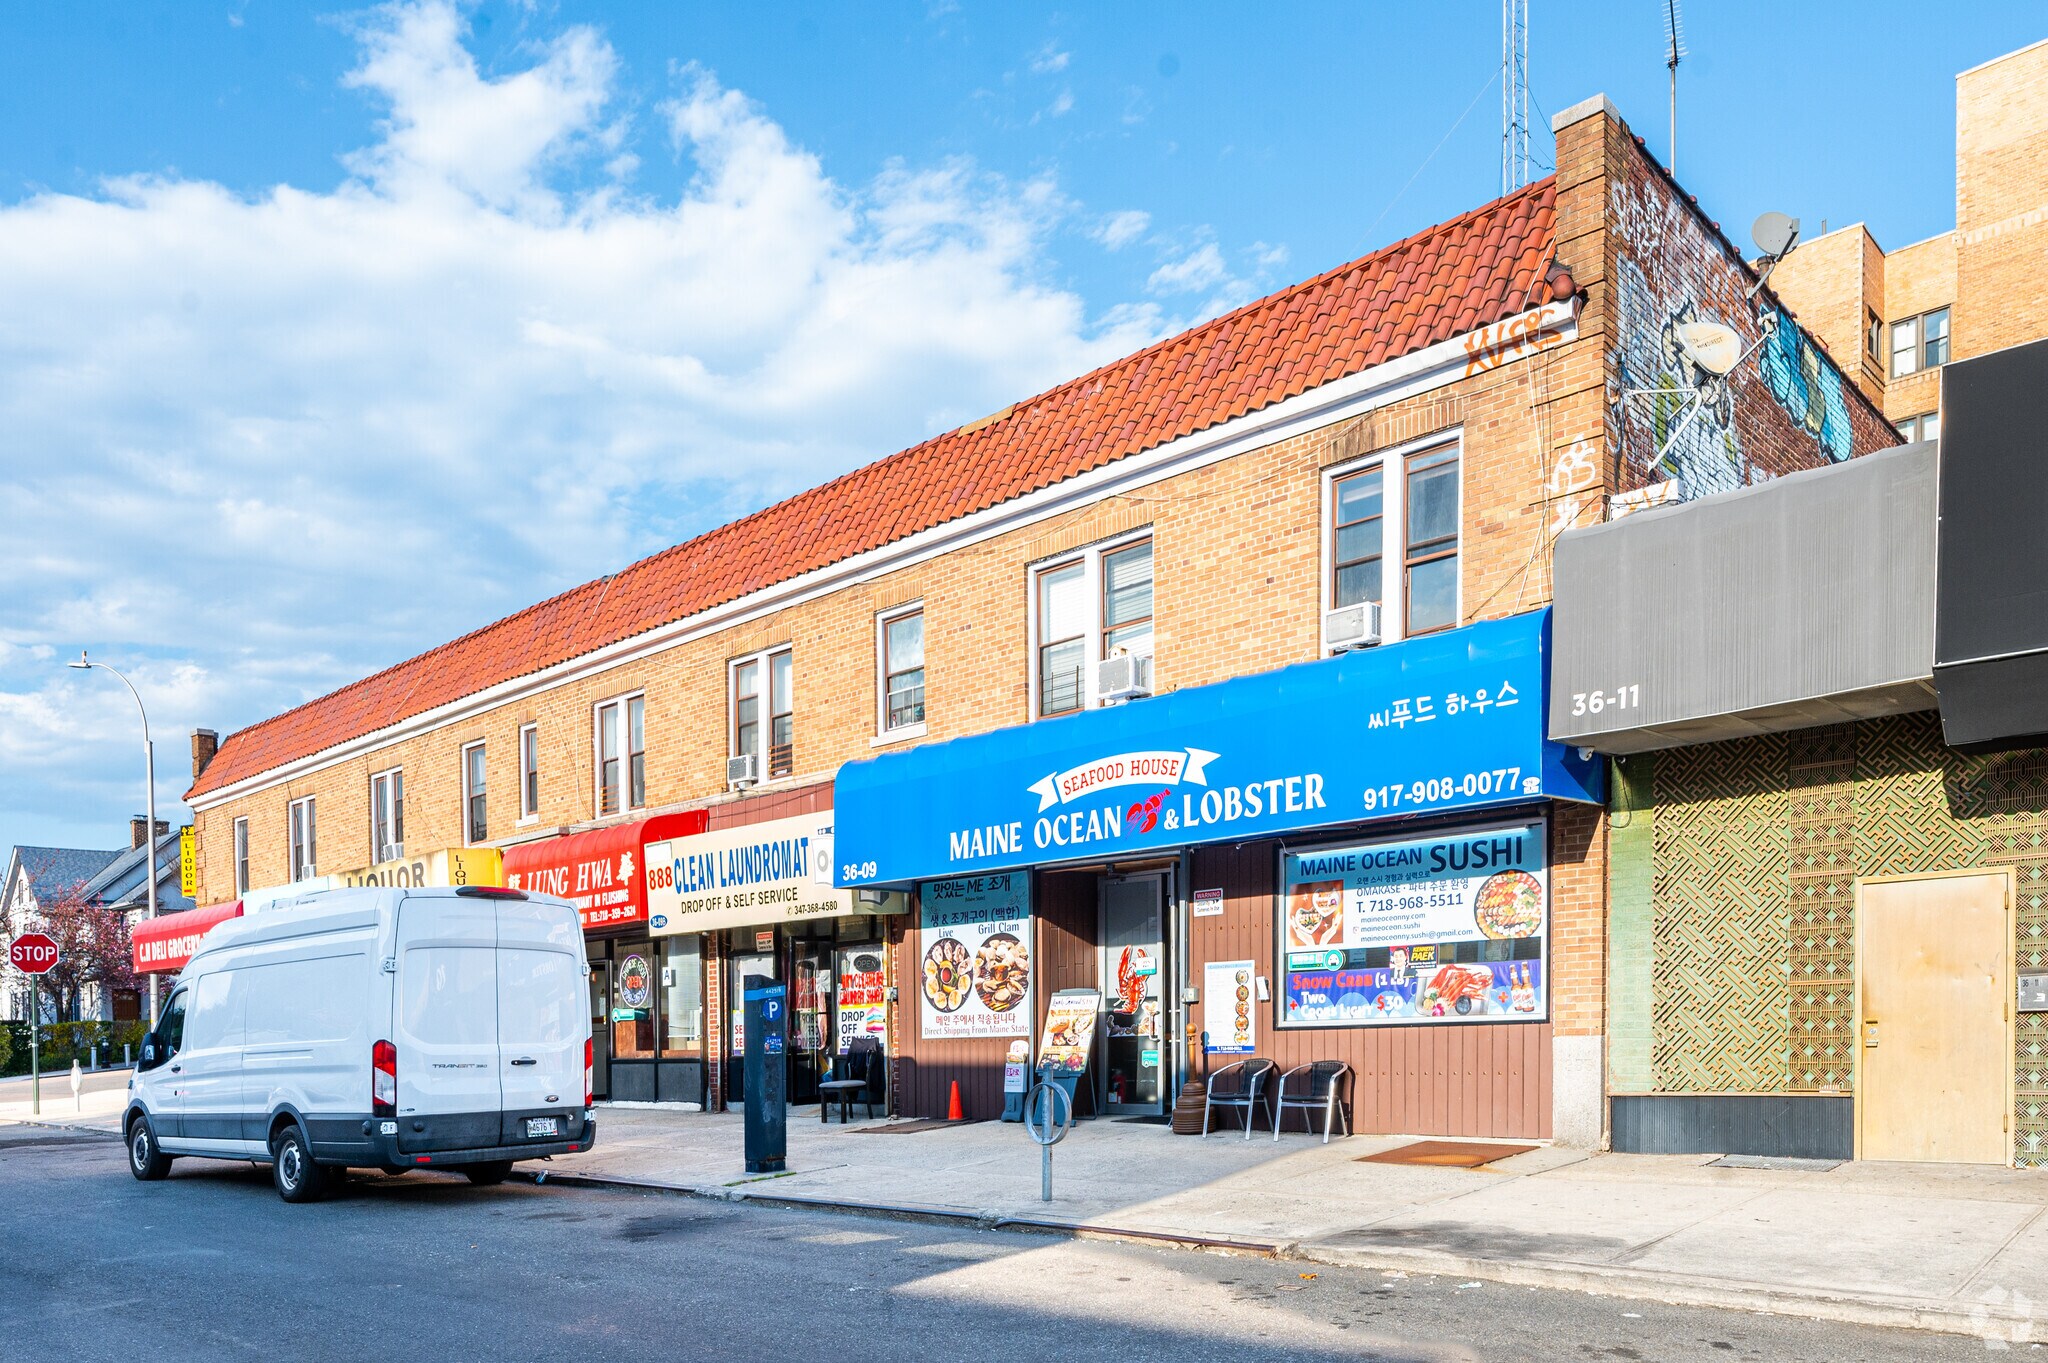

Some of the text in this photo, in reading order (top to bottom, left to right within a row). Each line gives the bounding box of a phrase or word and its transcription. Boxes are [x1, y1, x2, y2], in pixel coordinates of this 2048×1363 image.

[1368, 680, 1519, 729] 씨푸드 하우스
[1572, 684, 1639, 716] 36-11
[1063, 758, 1180, 796] SEAFOOD HOUSE
[1364, 767, 1520, 810] 917-908-0077
[949, 822, 1022, 862] MAINE
[1034, 806, 1121, 849] OCEAN
[1183, 773, 1326, 828] LOBSTER
[184, 843, 193, 886] LIQUOR
[649, 836, 808, 894] 888 CLEAN LAUNDROMAT
[1300, 836, 1522, 877] MAINE OCEAN SUSHI
[576, 858, 613, 892] HWA
[842, 861, 877, 882] 36-09
[1370, 876, 1383, 884] 스시
[1384, 874, 1404, 883] 경험과
[934, 874, 1010, 900] 맛있는 ME 조개
[1197, 891, 1220, 899] WARNING
[1356, 878, 1469, 897] OMAKASE 파티 주문 환영
[602, 888, 629, 906] FLUSHING
[681, 887, 798, 914] DROP OFF & SELF SERVICE
[1356, 893, 1464, 913] T. 718-968-5511
[794, 900, 838, 915] 347-368-4580
[931, 906, 1020, 927] 생 & 조개구이 (백합)
[1361, 913, 1426, 924] maineoceanny.com
[939, 927, 954, 938] Live
[978, 922, 1020, 935] Grill Clam
[1361, 923, 1420, 932] maineocean.sushi
[1361, 929, 1473, 942] maineoceanny.sushi@gmail.com
[12, 946, 56, 962] STOP
[152, 940, 167, 960] DELI
[168, 934, 200, 958] GROCERY
[856, 960, 877, 968] OPEN
[1411, 952, 1434, 961] PAEK
[664, 970, 670, 980] A
[769, 1001, 778, 1018] P
[1377, 995, 1403, 1011] $30
[841, 1012, 864, 1022] DROP
[841, 1024, 858, 1034] OFF
[925, 1024, 1028, 1036] Direct Shipping From Maine State
